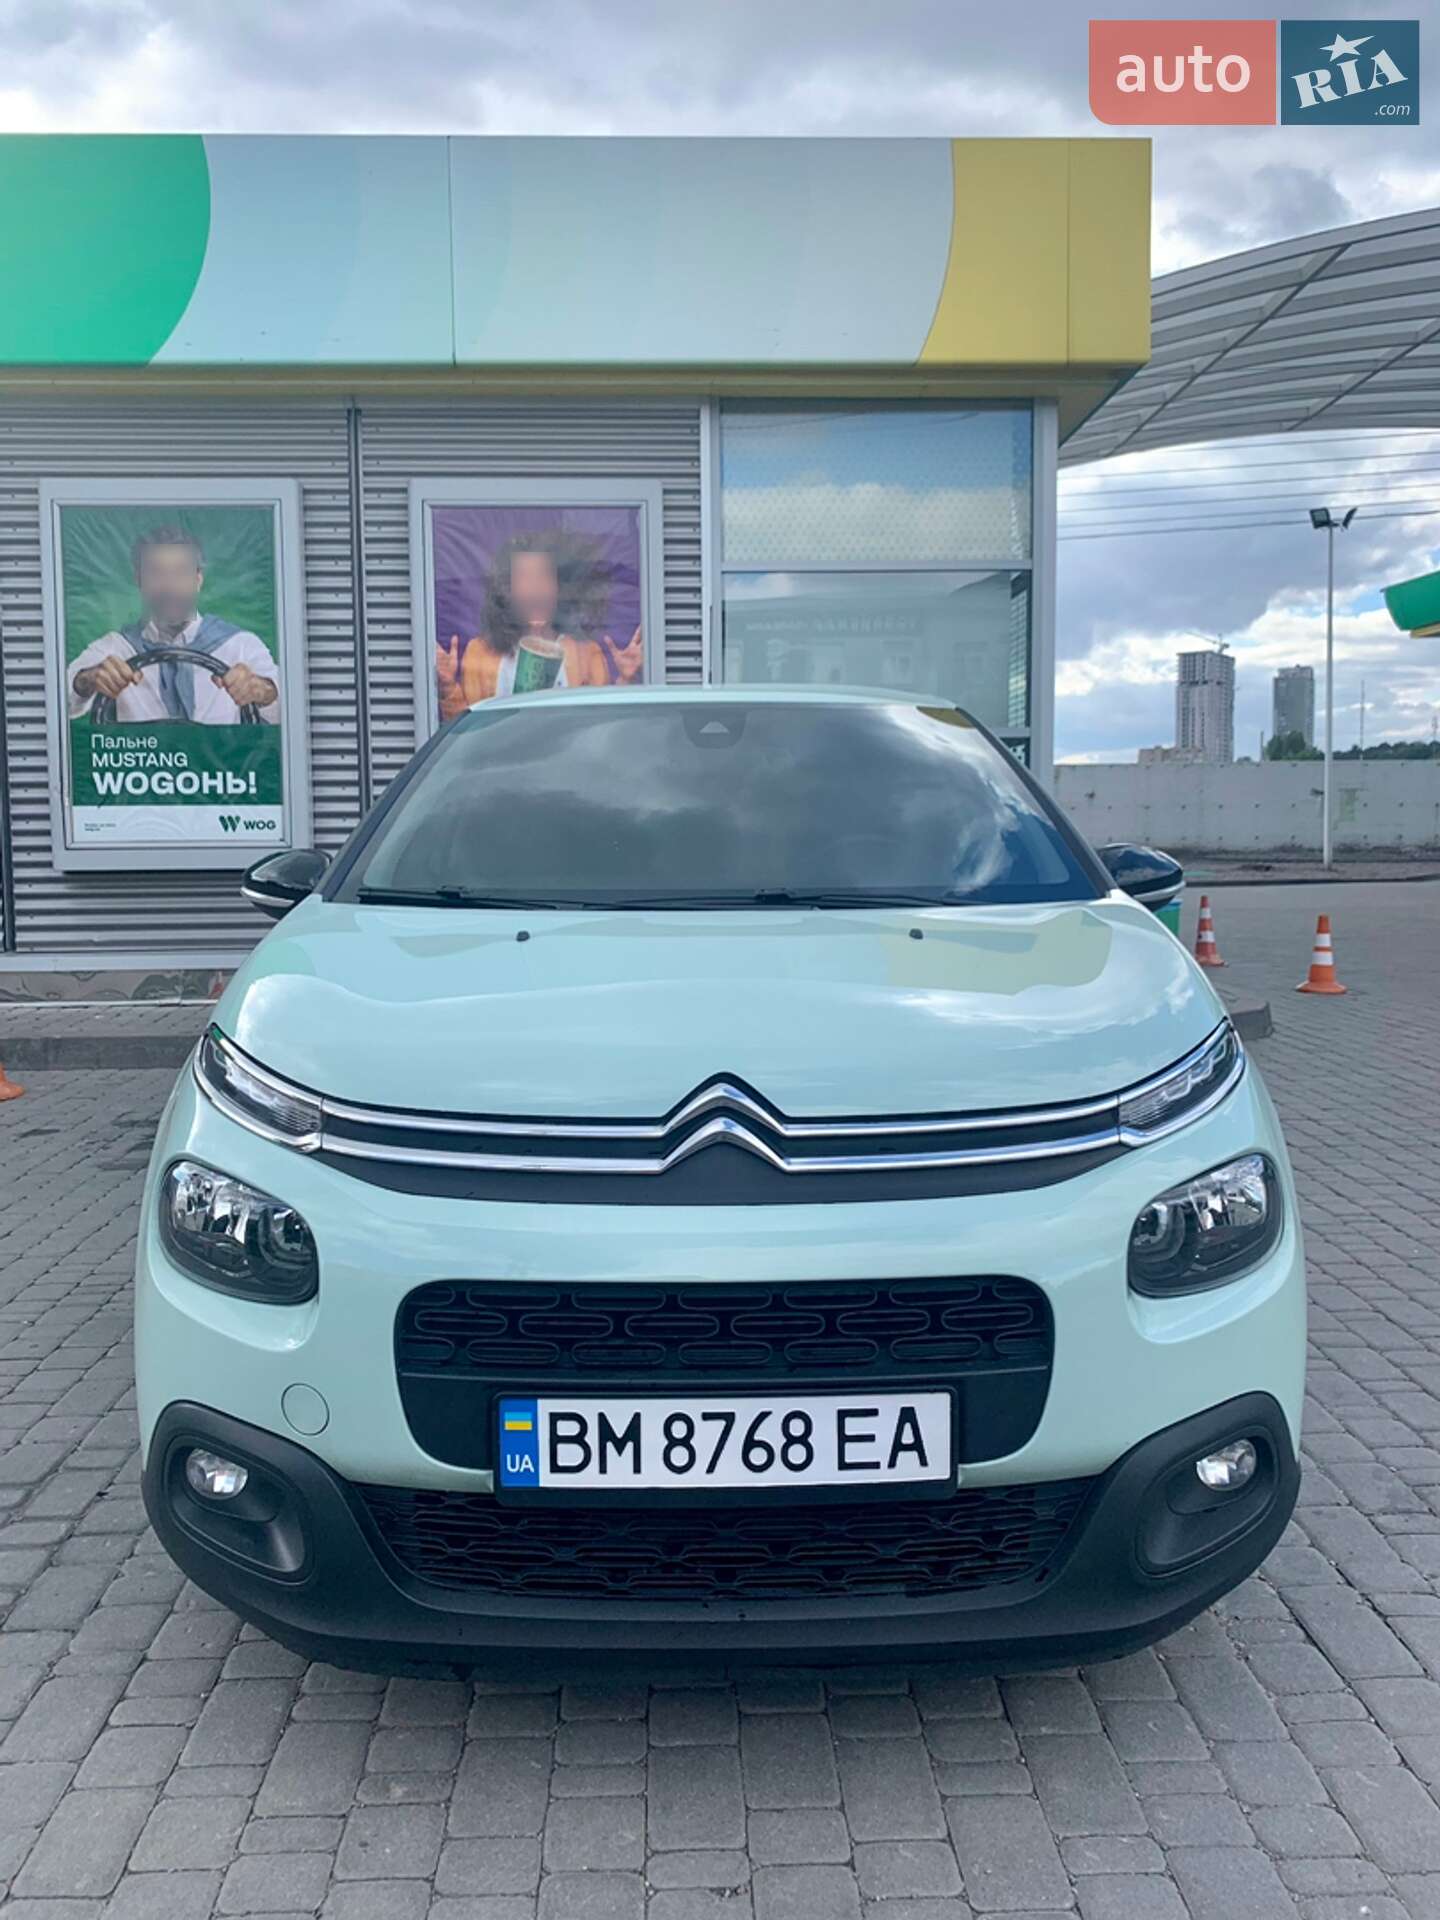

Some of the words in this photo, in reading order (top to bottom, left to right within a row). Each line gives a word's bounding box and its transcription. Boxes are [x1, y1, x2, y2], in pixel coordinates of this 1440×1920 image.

[91, 734, 157, 749] Пальне
[92, 752, 188, 767] MUSTANG
[244, 819, 276, 830] WOG
[549, 1411, 642, 1475] BM
[663, 1409, 814, 1475] 8768
[837, 1406, 928, 1471] EA
[507, 1454, 534, 1473] UA
